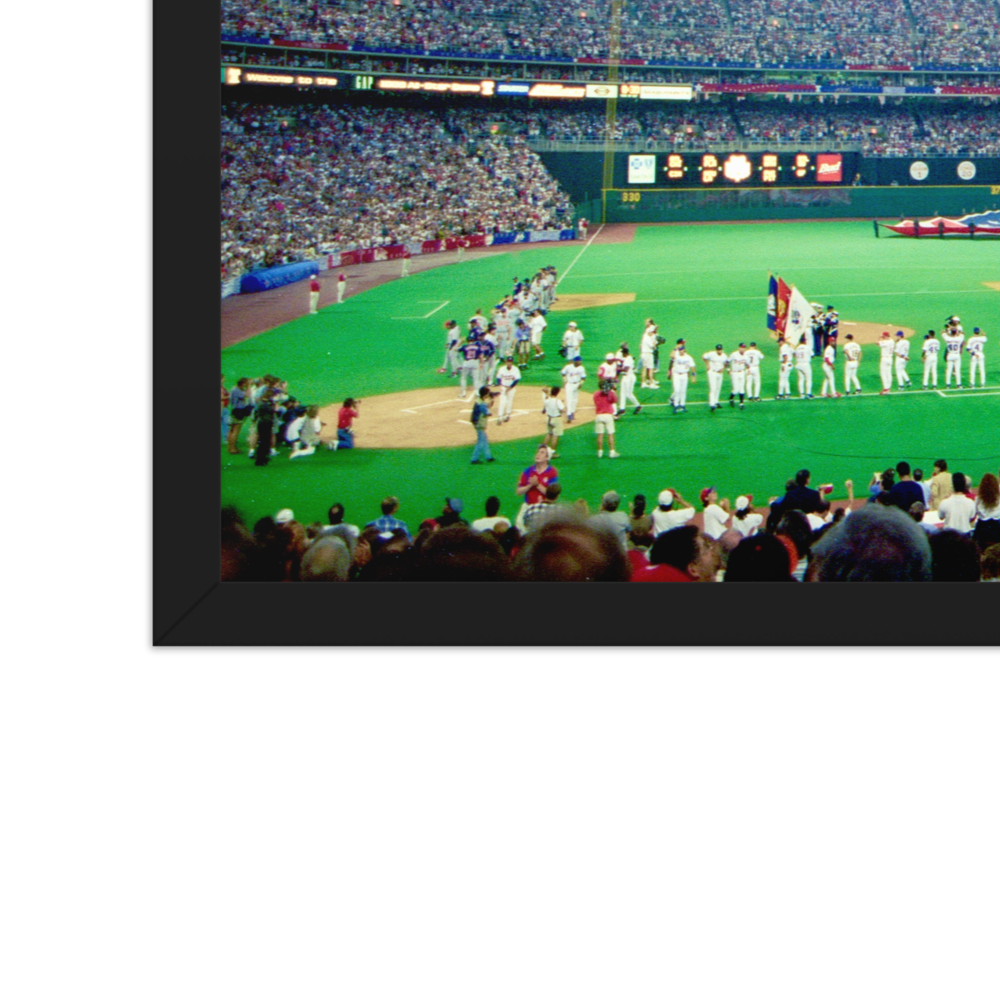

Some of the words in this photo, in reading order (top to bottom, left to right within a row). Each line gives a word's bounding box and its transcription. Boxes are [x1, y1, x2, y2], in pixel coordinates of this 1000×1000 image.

[246, 73, 294, 84] Welcome
[297, 76, 313, 85] to
[316, 77, 338, 86] the
[622, 192, 641, 202] 330
